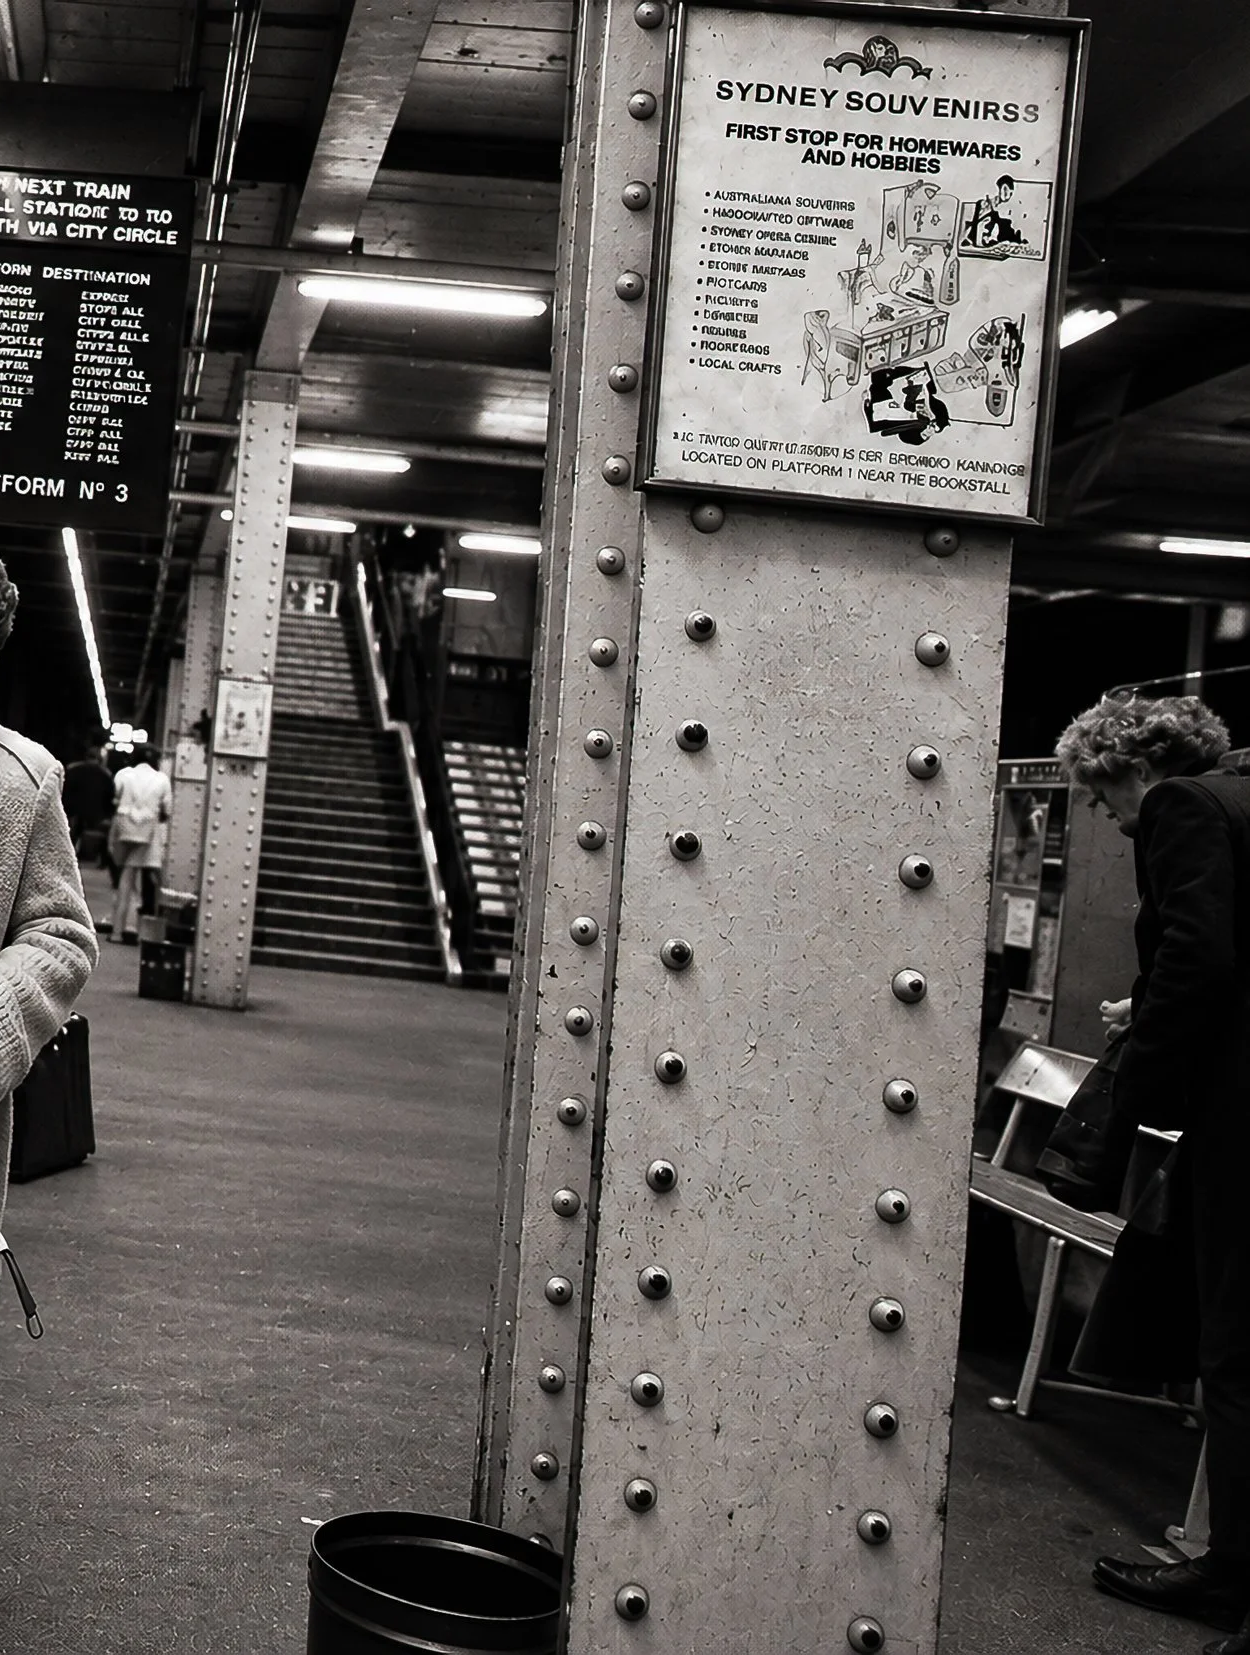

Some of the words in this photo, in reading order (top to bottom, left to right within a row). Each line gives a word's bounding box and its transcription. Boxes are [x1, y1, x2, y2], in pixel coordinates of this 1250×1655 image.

[716, 79, 839, 109] SYDNEY
[725, 122, 781, 141] FIRST
[784, 128, 838, 147] STOP
[842, 132, 883, 151] FOR
[889, 136, 1022, 162] HOMEWARES
[801, 148, 846, 166] AND
[851, 151, 941, 175] HOBBIES
[15, 178, 66, 197] NEXT
[73, 181, 131, 200] TRAIN
[27, 220, 58, 238] VIA
[65, 223, 108, 241] CITY
[112, 227, 179, 246] CIRCLE
[699, 358, 735, 370] LOCAL
[681, 450, 743, 467] LOCATED
[746, 457, 767, 470] ON
[771, 459, 843, 478] PLATFORM
[857, 468, 896, 483] NEAR
[900, 472, 926, 487] THE
[928, 475, 1011, 495] BOOKSTALL
[114, 483, 129, 503] 3
